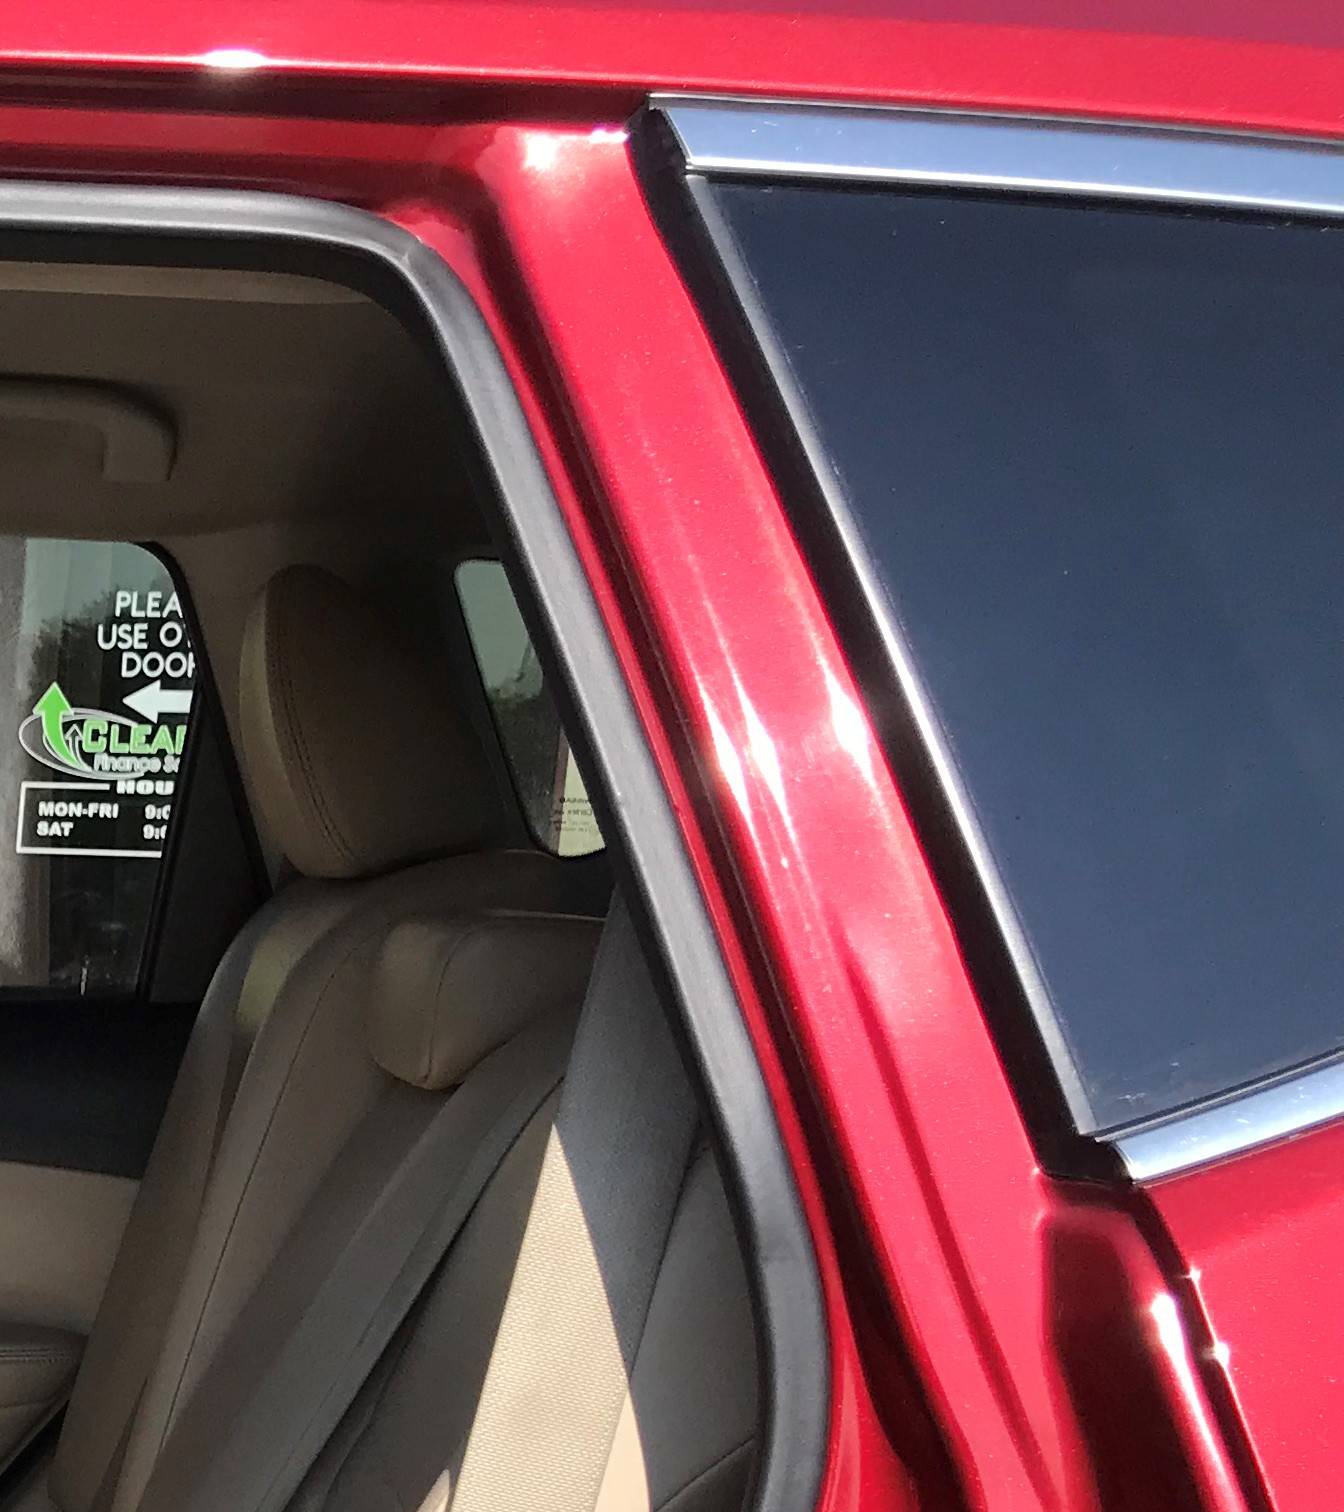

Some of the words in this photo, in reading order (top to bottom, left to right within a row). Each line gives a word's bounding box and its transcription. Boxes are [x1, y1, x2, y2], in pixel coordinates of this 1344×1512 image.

[114, 590, 184, 619] PLEA
[97, 622, 149, 651] USE
[37, 801, 120, 819] MON-FRI
[36, 820, 74, 837] SAT
